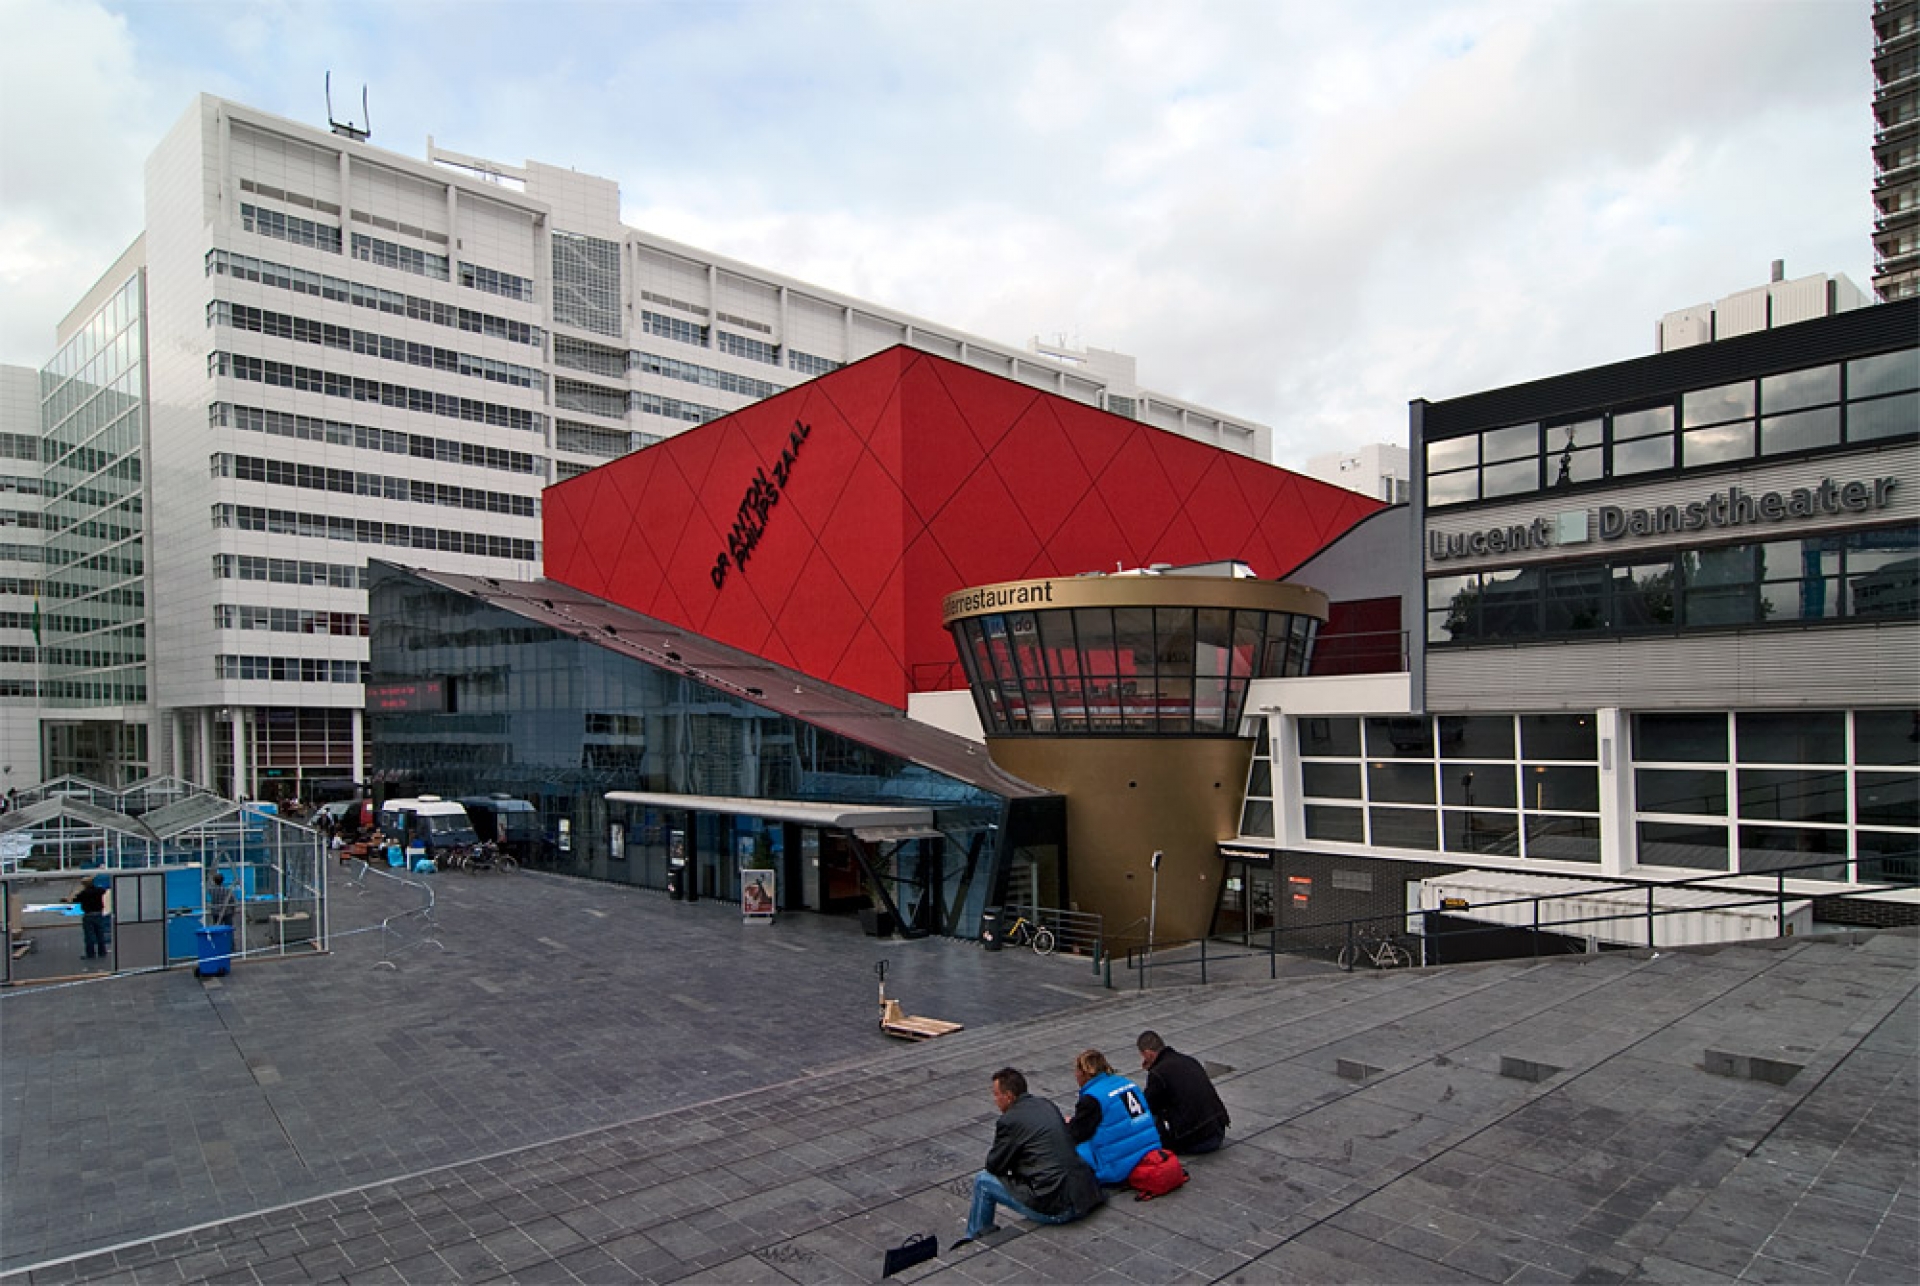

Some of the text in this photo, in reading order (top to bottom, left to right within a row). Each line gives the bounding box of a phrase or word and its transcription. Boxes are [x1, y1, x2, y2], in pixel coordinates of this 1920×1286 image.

[727, 466, 767, 557] ANTON
[1429, 474, 1898, 560] Lucent Danstheater
[1126, 1091, 1143, 1114] 4
